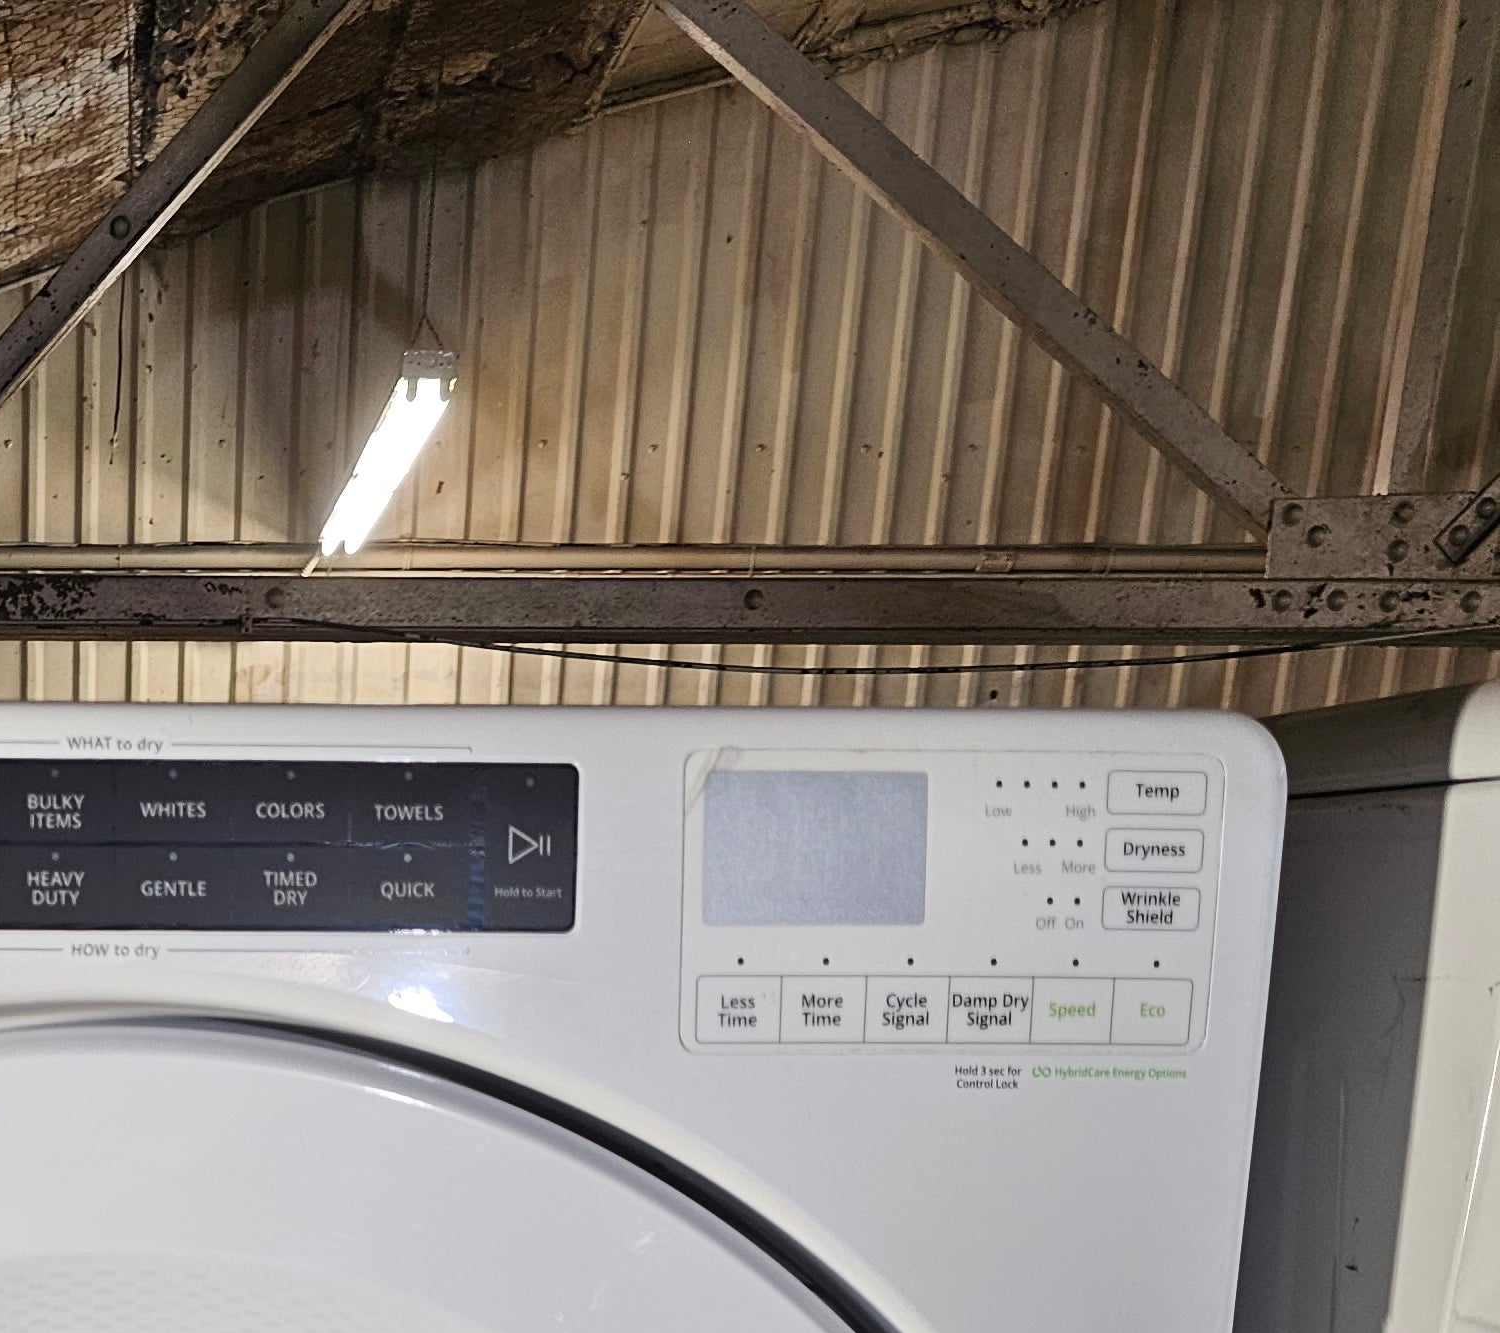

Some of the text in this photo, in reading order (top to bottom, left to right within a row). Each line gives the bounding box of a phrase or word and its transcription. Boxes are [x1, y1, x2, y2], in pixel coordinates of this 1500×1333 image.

[68, 737, 163, 753] WHAT to dry
[1137, 784, 1179, 801] Temp
[28, 794, 84, 810] BULKY
[140, 802, 206, 818] WHITES
[256, 802, 324, 818] COLORS
[375, 804, 443, 820] TOWELS
[986, 805, 1011, 816] Low
[1066, 806, 1095, 821] High
[30, 813, 81, 829] ITEMS
[1124, 842, 1185, 859] Dryness
[1014, 864, 1041, 874] Less
[1062, 861, 1095, 873] More
[27, 870, 84, 886] HEAVY
[264, 870, 317, 887] TIMED
[141, 880, 206, 896] GENTLE
[381, 881, 434, 900] QUICK
[495, 887, 562, 898] Hold to Start
[32, 890, 79, 905] DUTY
[274, 890, 307, 905] DRY
[1122, 892, 1180, 905] Wrinkle
[1036, 917, 1055, 928] Off
[1065, 918, 1083, 929] On
[1128, 910, 1173, 924] Shield
[72, 944, 160, 960] HOW to dry
[722, 995, 755, 1009] Less
[802, 994, 843, 1007] More
[887, 994, 927, 1012] Cycle
[953, 994, 1028, 1014] Damp Dry
[1050, 1003, 1095, 1020] Speed
[1140, 1003, 1165, 1017] Eco
[719, 1014, 757, 1026] Time
[803, 1012, 841, 1026] Time
[883, 1011, 929, 1029] Signal
[968, 1011, 1011, 1029] Signal
[955, 1066, 1020, 1076] Hold 3 sec for
[1055, 1067, 1186, 1080] HybridCare Energy Options
[957, 1079, 1018, 1089] Control Lock
